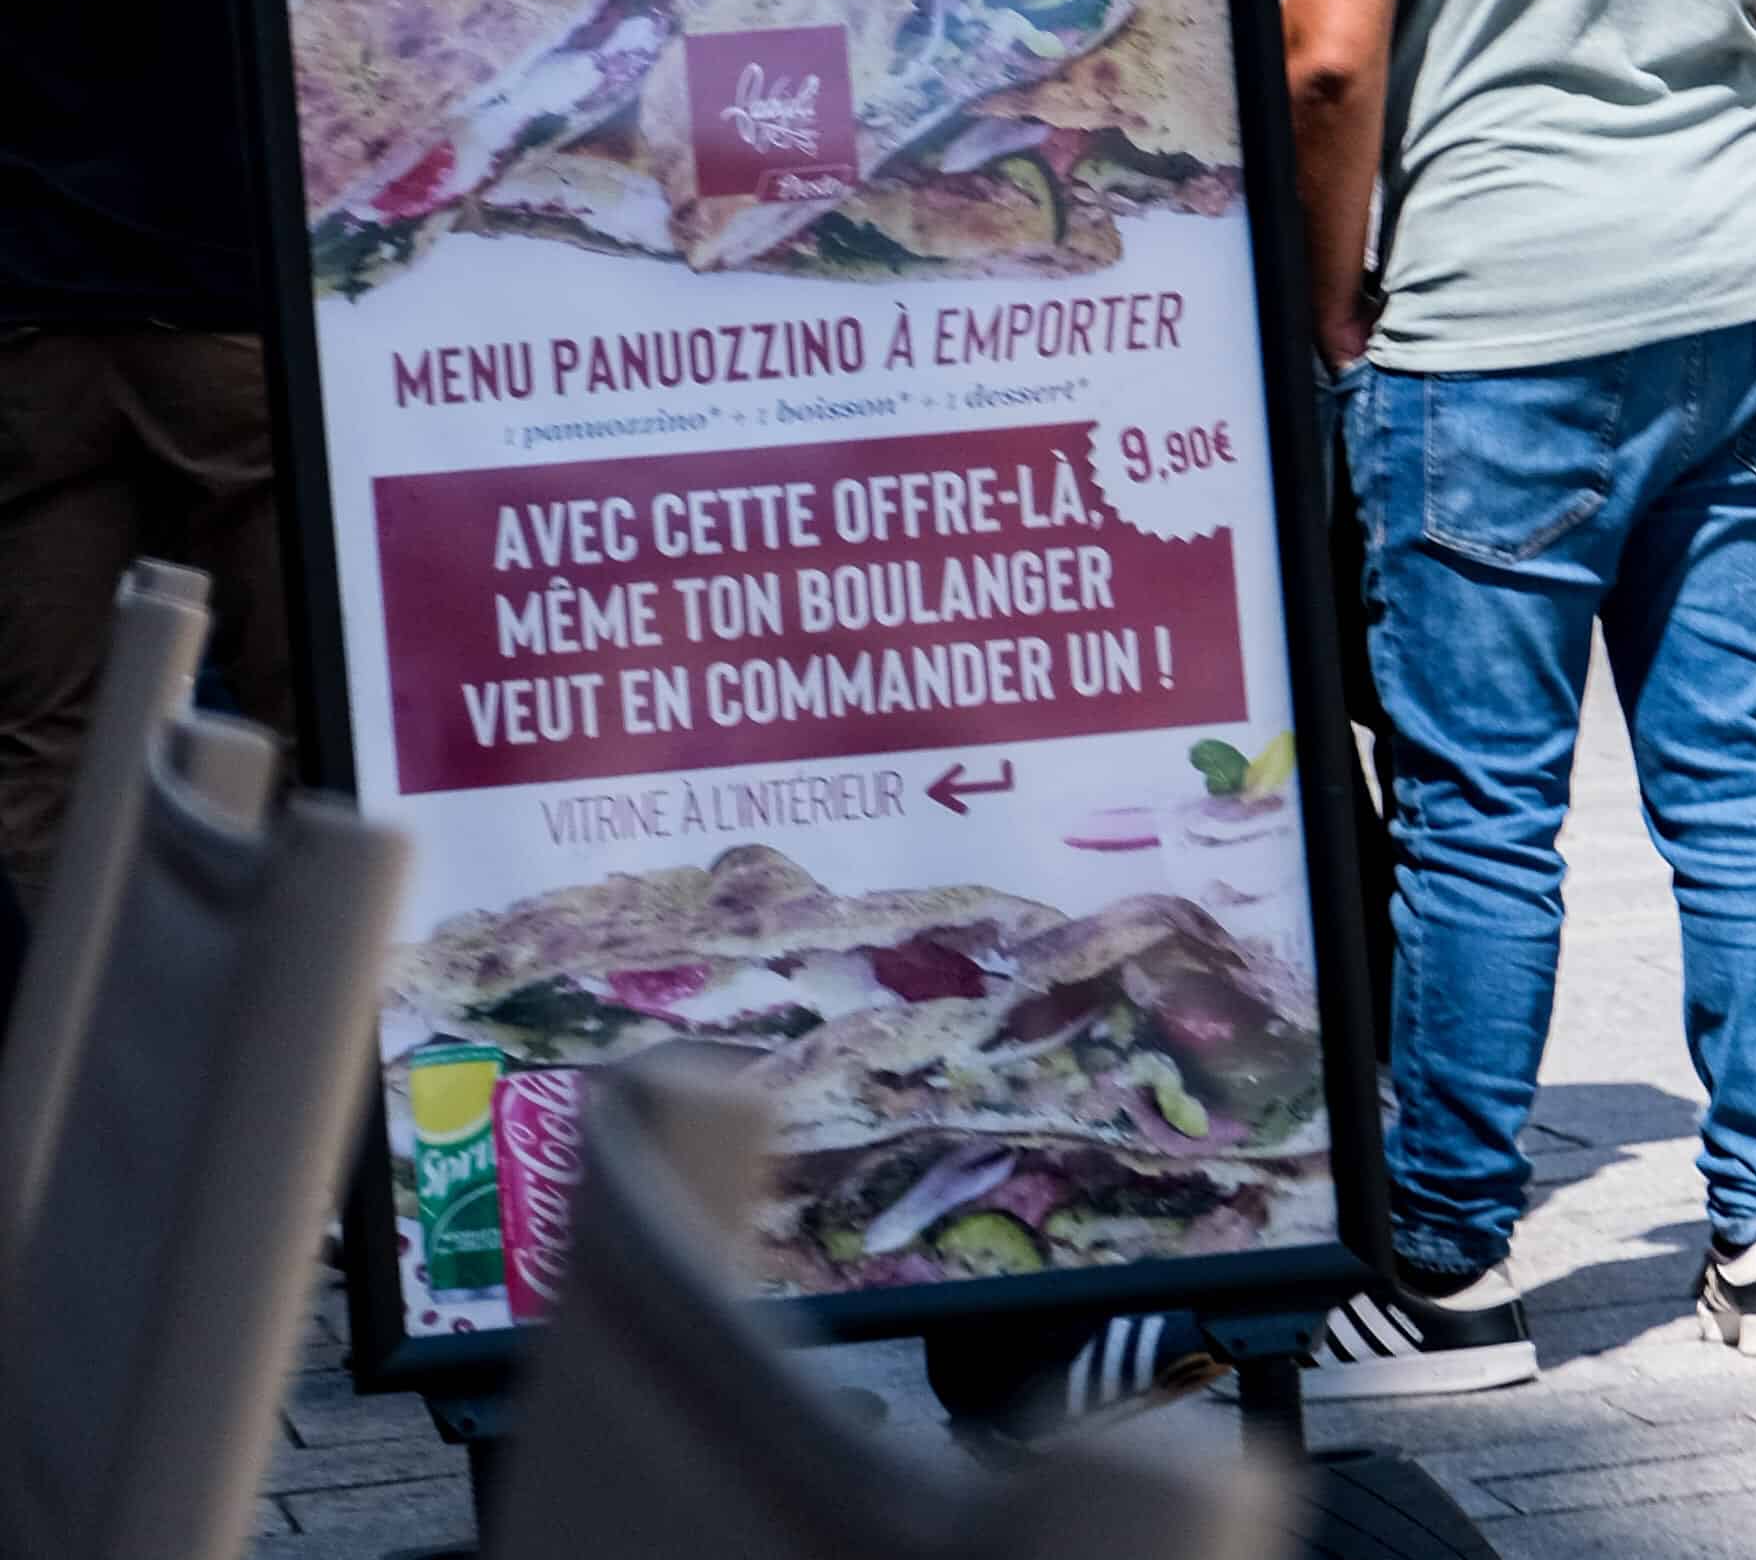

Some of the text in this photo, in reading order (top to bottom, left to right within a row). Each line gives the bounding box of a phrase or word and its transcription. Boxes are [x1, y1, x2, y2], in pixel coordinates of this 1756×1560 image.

[392, 291, 1184, 408] MENU PANUOZZINO À EMPORTER
[493, 448, 1104, 572] AVEC CETTE OFFRE-LÀ,
[496, 545, 1115, 658] MÊME TON BOULANGER
[462, 624, 1176, 748] VEUT EN COMMANDER UN !
[539, 789, 673, 846] VITRINE
[680, 778, 706, 833] À
